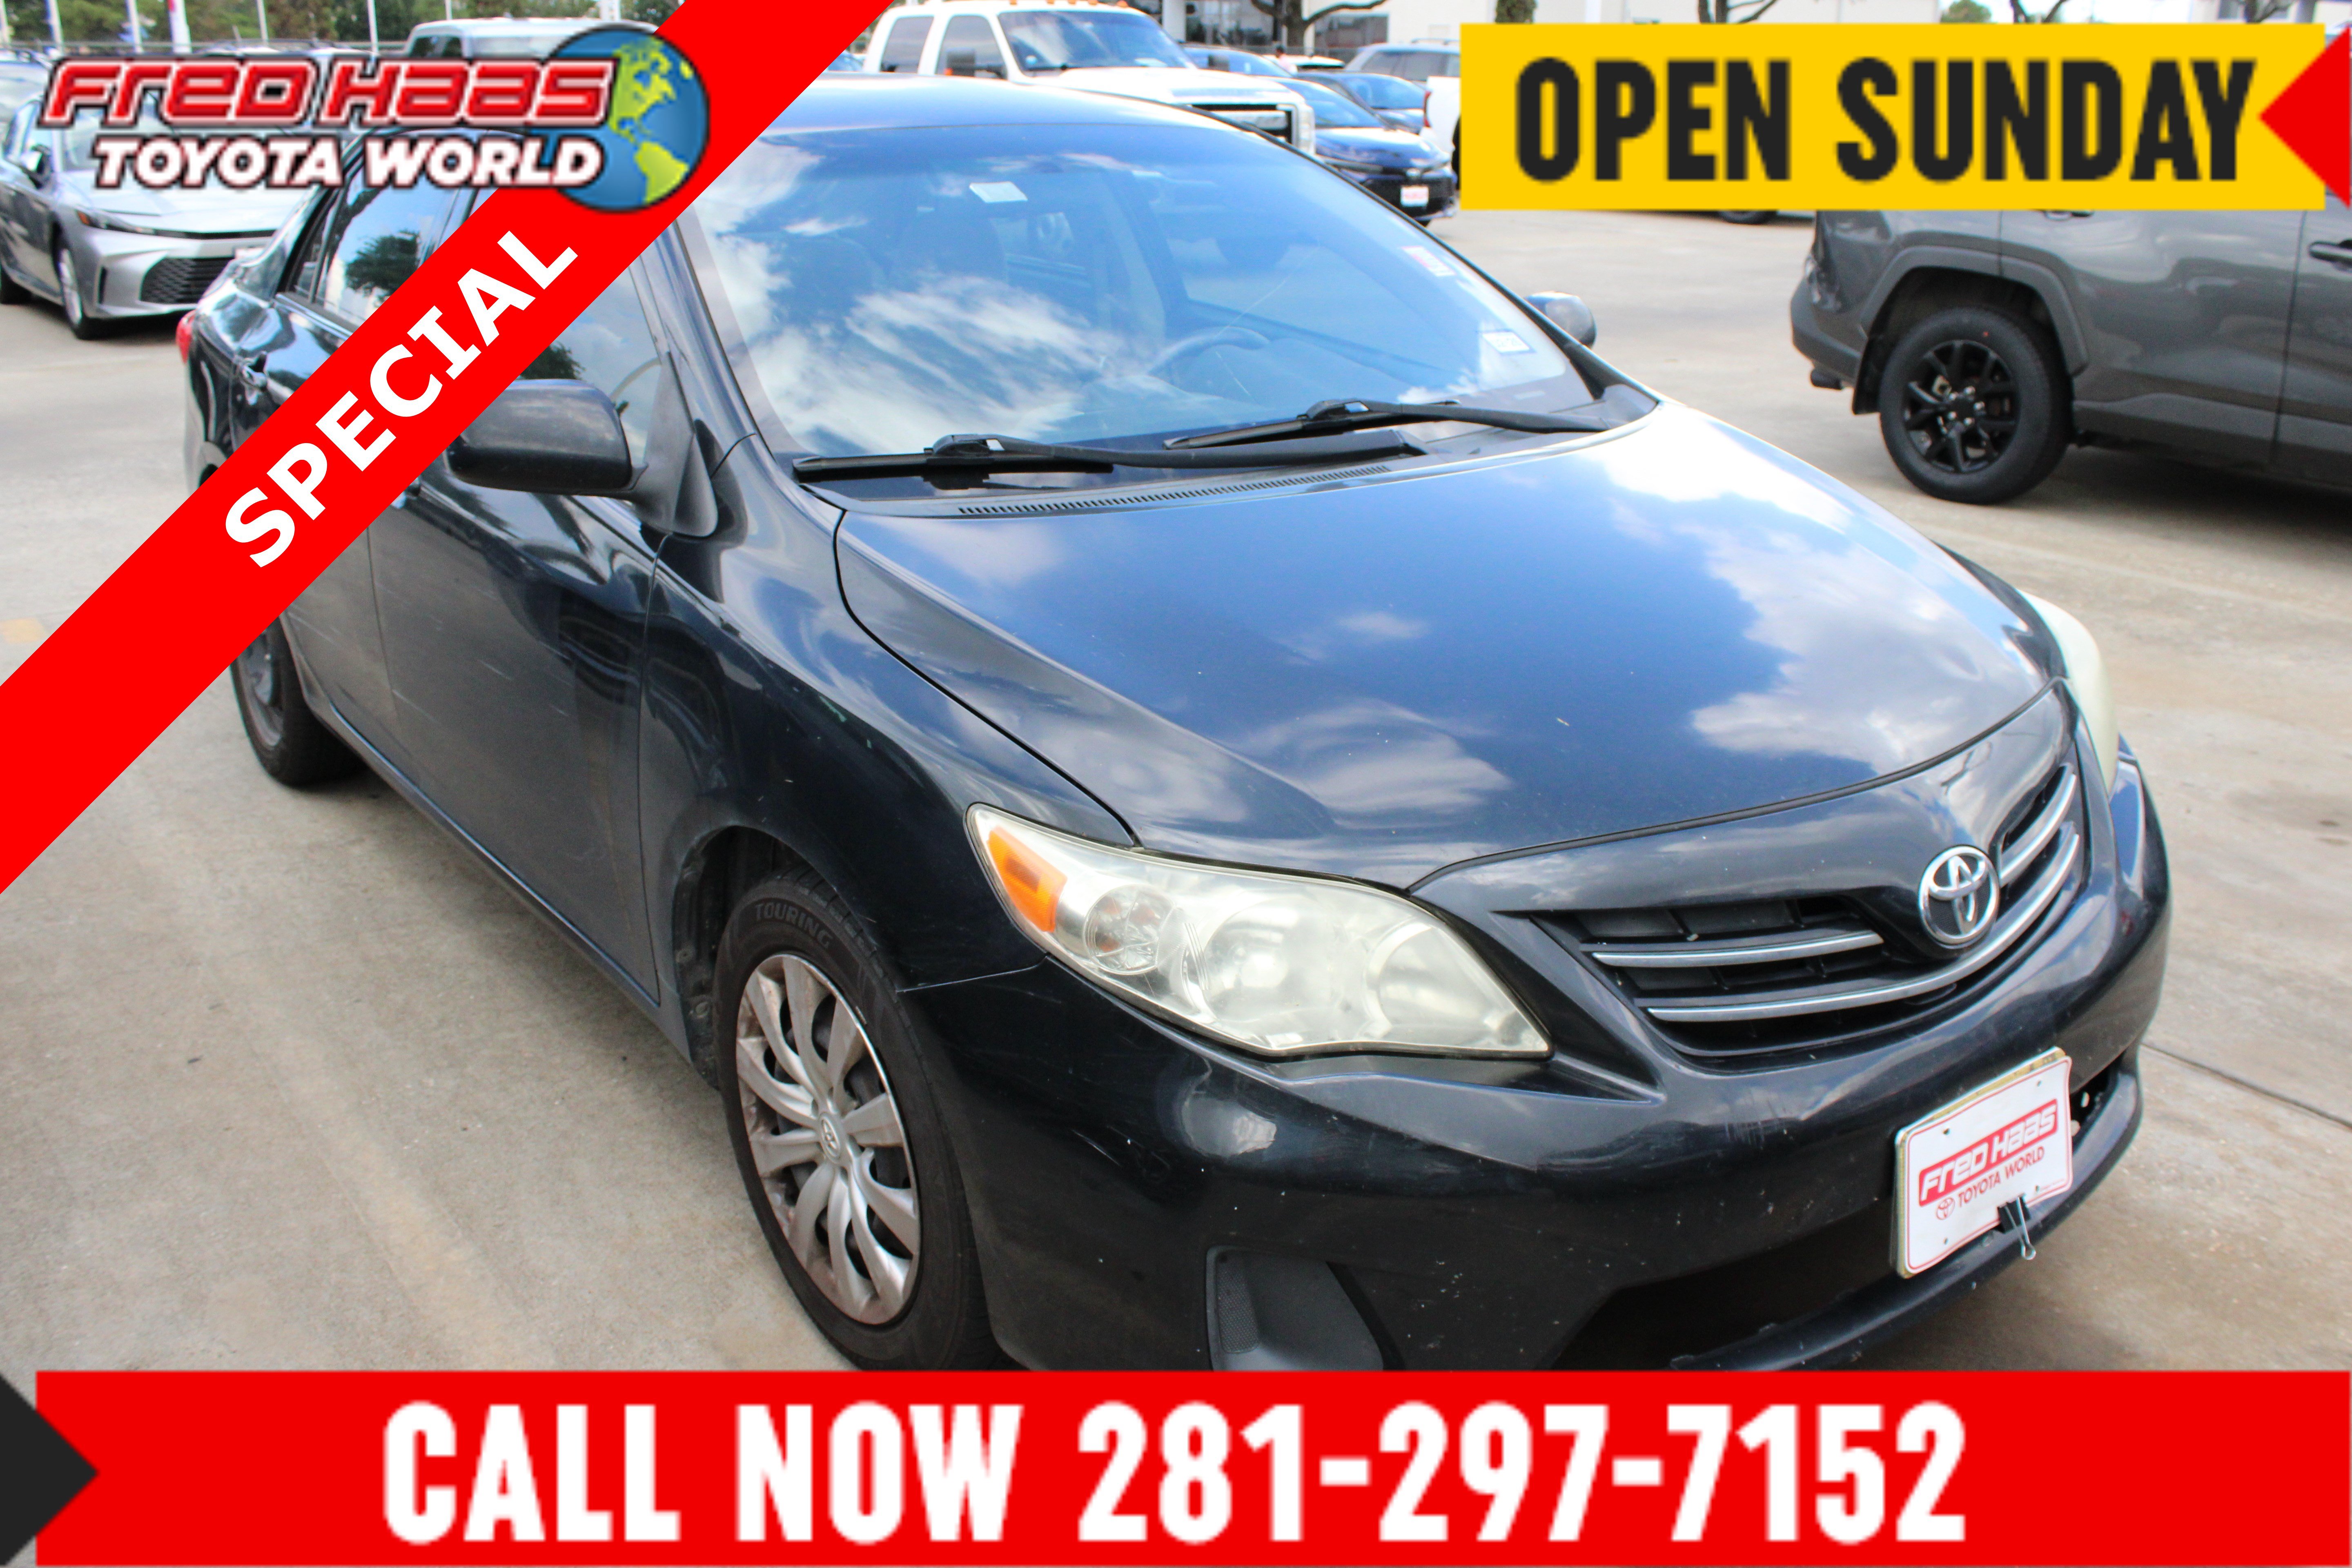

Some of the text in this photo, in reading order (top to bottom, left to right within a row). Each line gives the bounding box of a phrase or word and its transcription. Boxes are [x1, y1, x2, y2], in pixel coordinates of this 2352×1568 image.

[755, 902, 835, 949] TOURING
[1958, 1171, 2001, 1207] TOYOTA
[2005, 1145, 2045, 1179] WORLD
